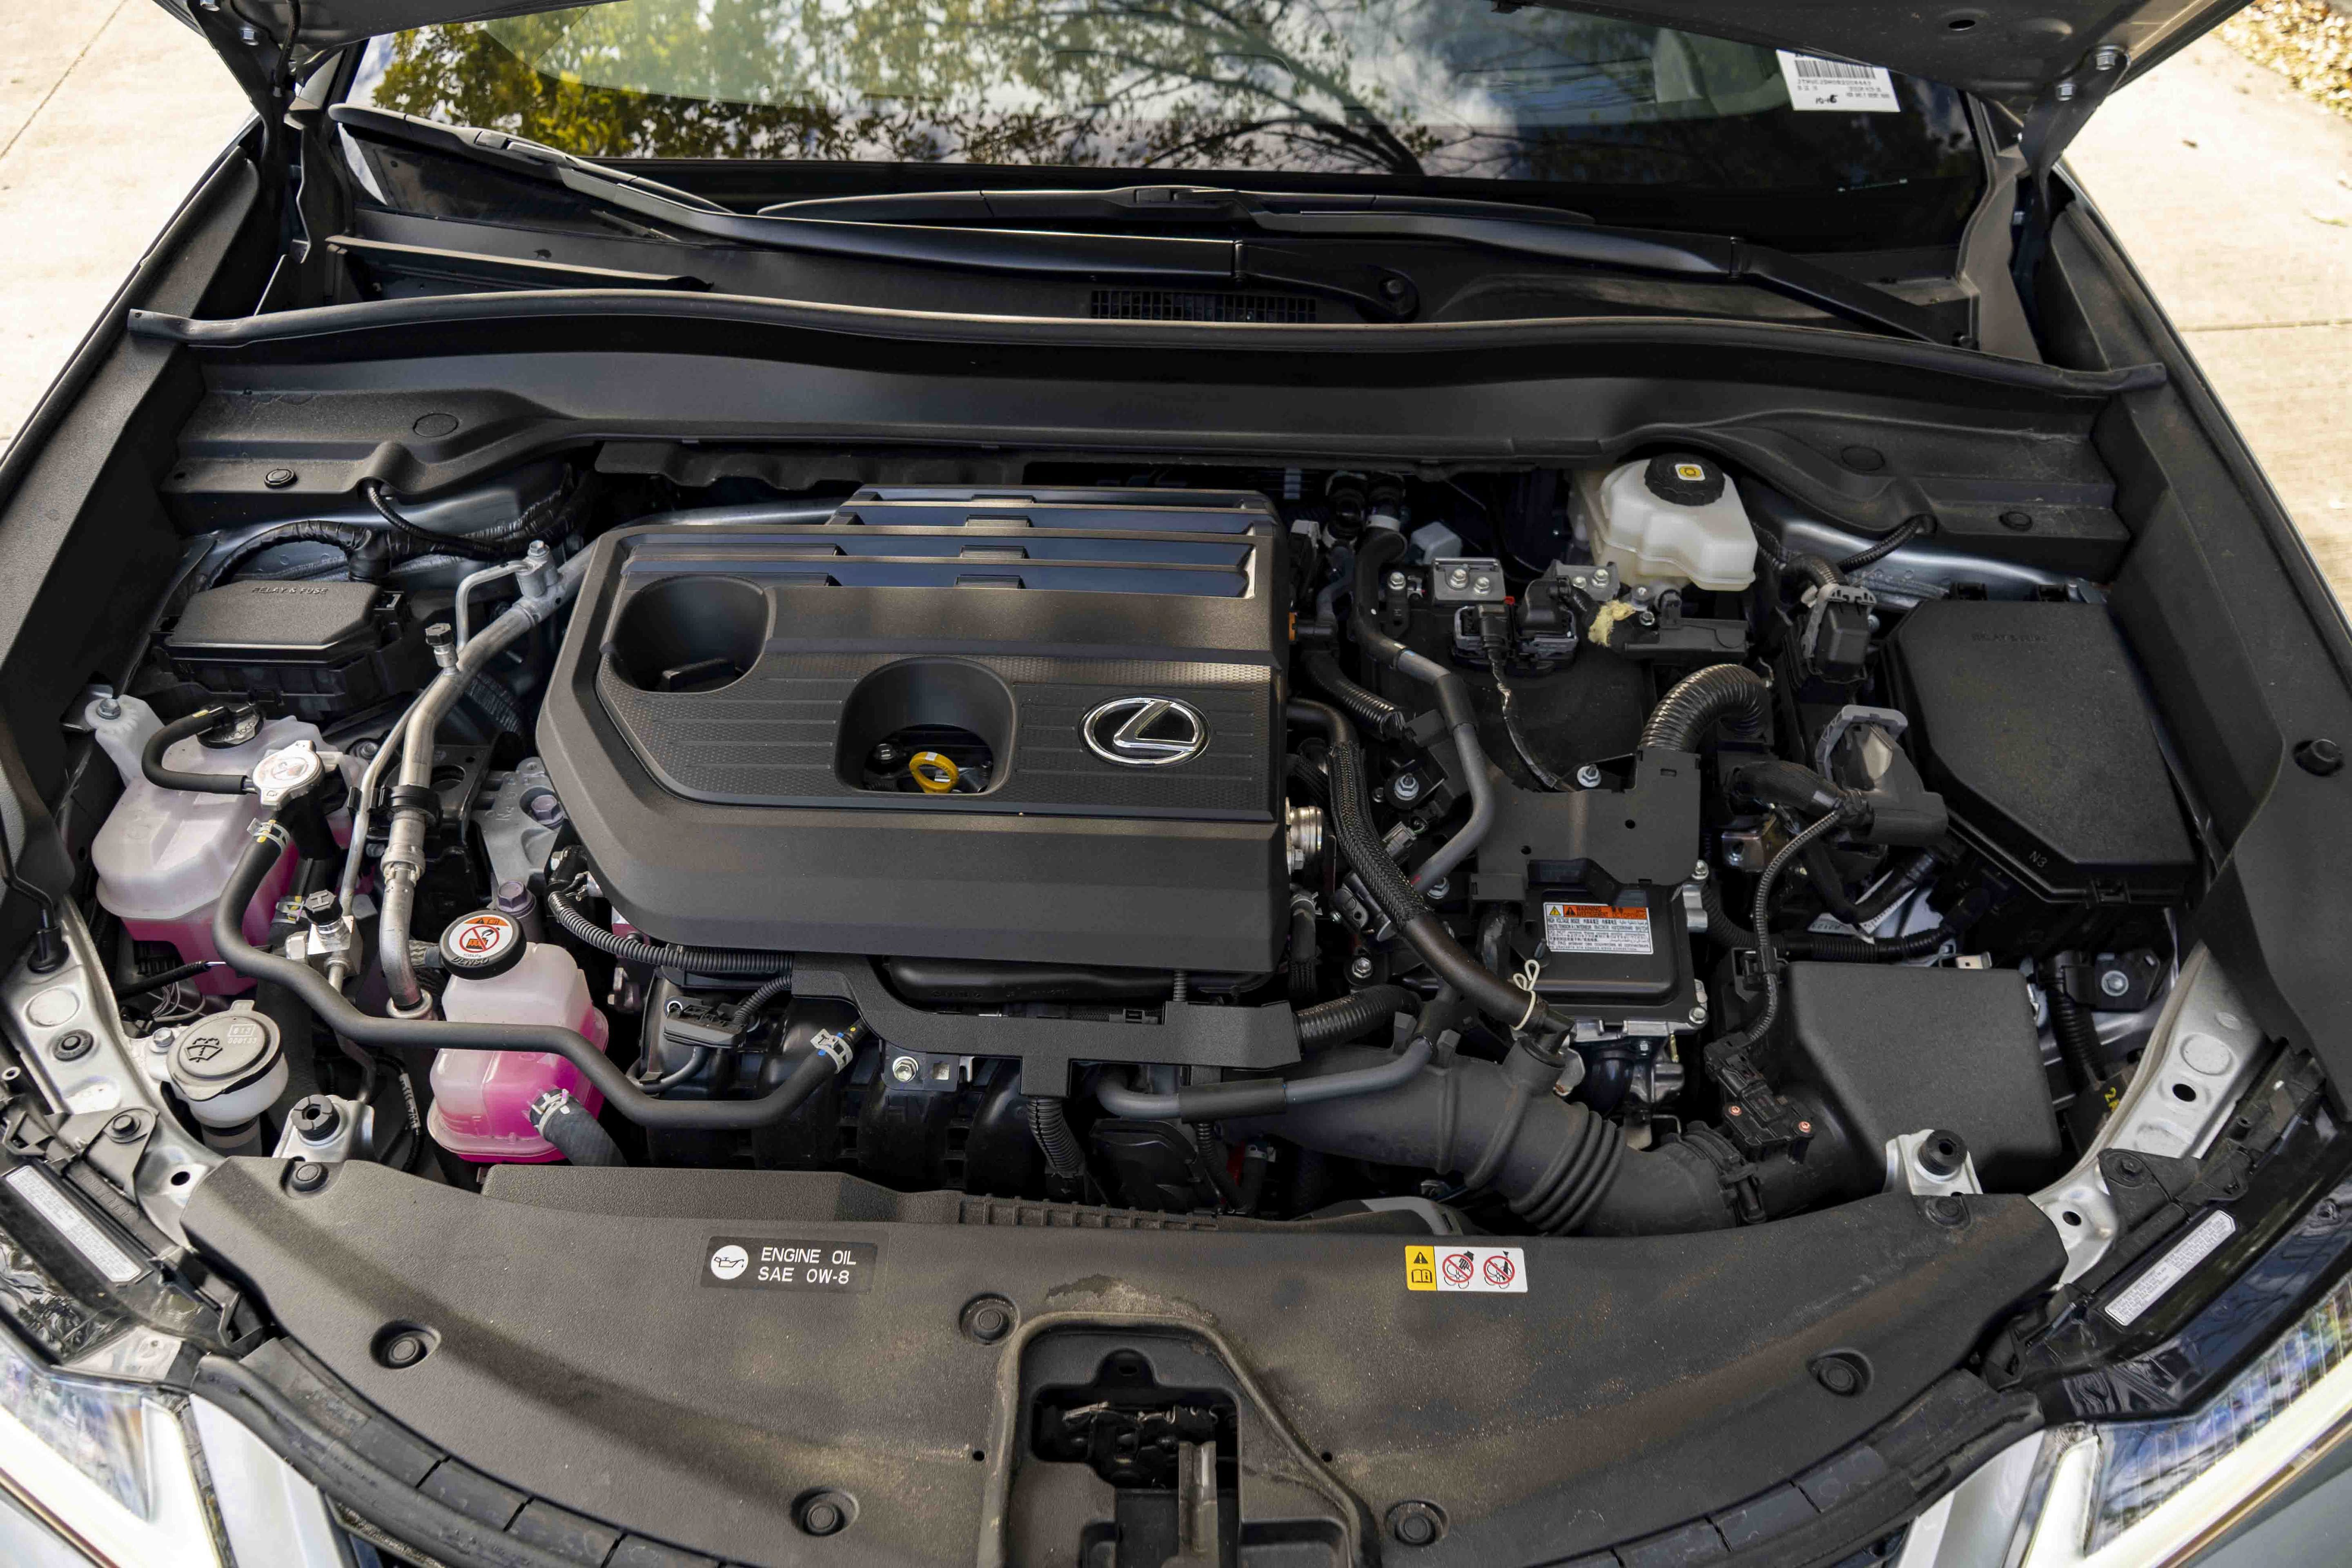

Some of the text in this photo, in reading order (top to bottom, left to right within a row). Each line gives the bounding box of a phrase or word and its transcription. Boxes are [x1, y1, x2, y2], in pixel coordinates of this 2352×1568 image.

[451, 957, 490, 966] DENSO
[761, 1247, 856, 1265] ENGINE OIL
[758, 1266, 849, 1284] SAE 0W-8
